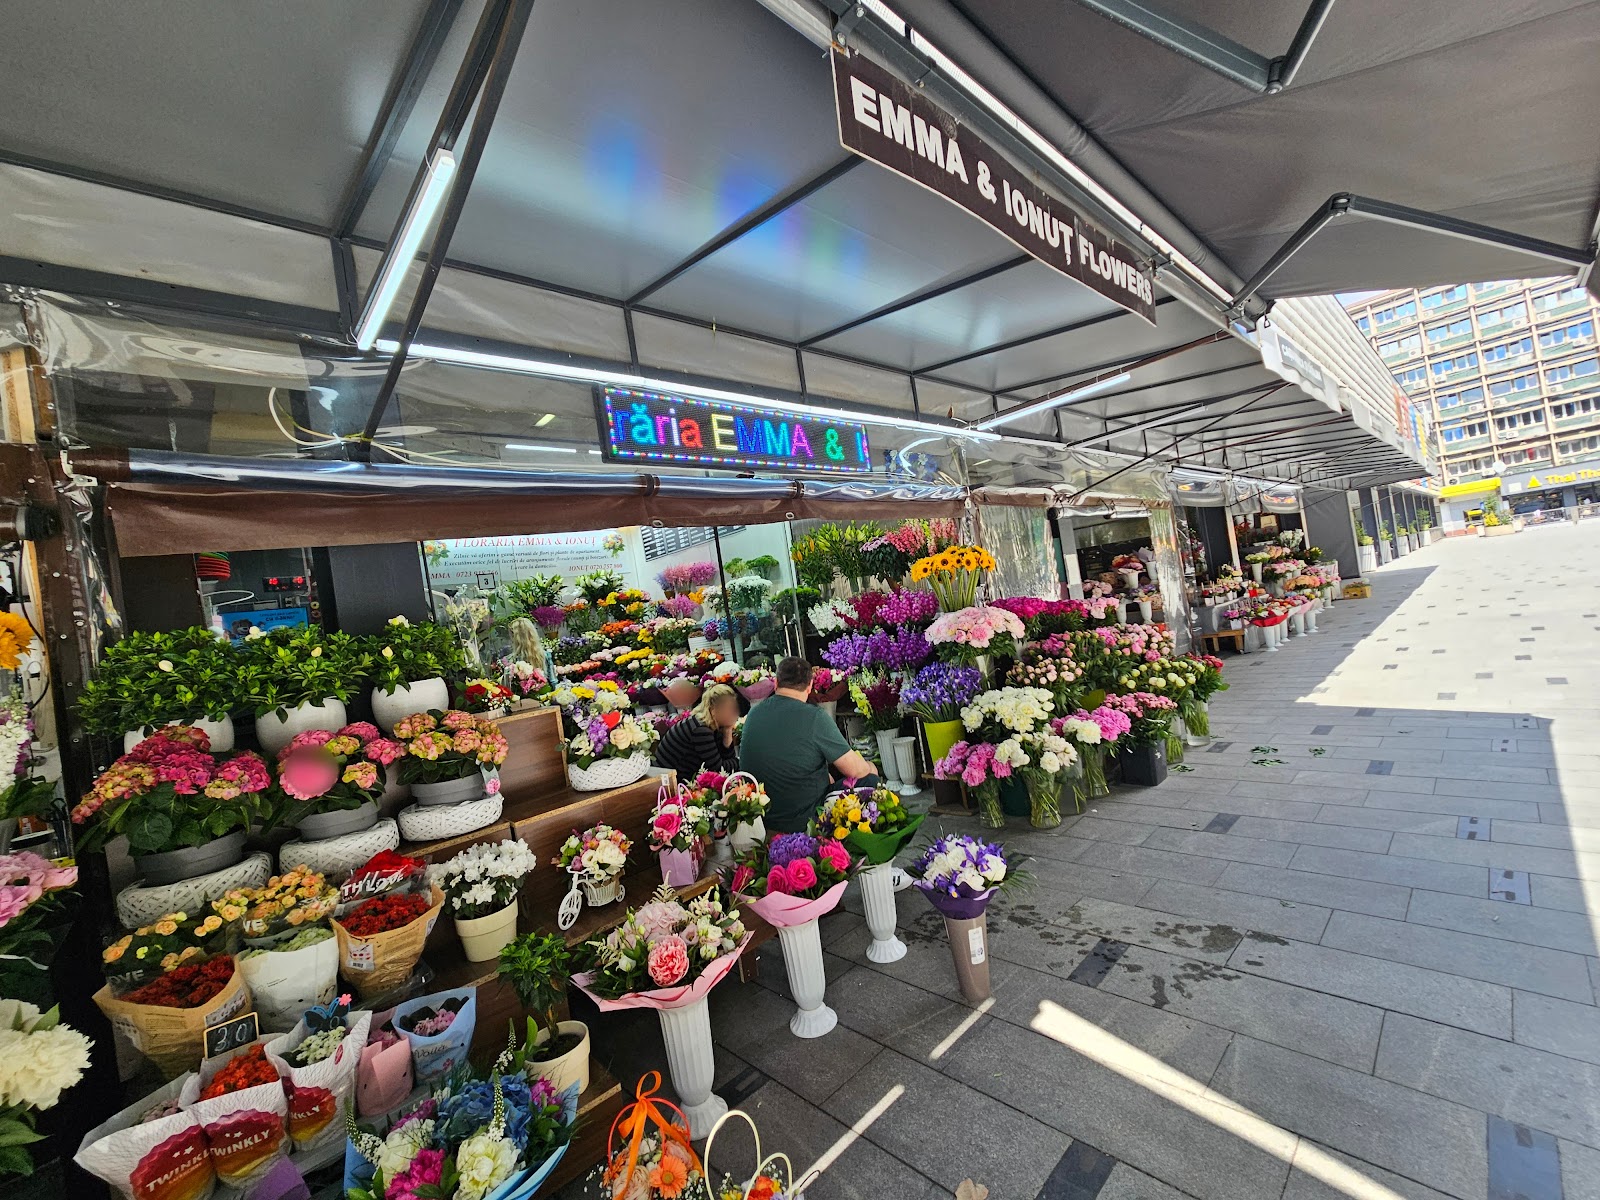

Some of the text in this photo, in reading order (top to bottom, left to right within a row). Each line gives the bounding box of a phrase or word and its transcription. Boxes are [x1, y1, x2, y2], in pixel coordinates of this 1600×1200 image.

[850, 75, 969, 184] EMMA
[977, 160, 997, 204] &
[1078, 233, 1152, 305] FLOWERS
[711, 413, 814, 458] EMMA
[820, 428, 845, 461] &
[518, 537, 552, 546] EMMA
[555, 537, 562, 545] &
[146, 1149, 209, 1192] TWINKL
